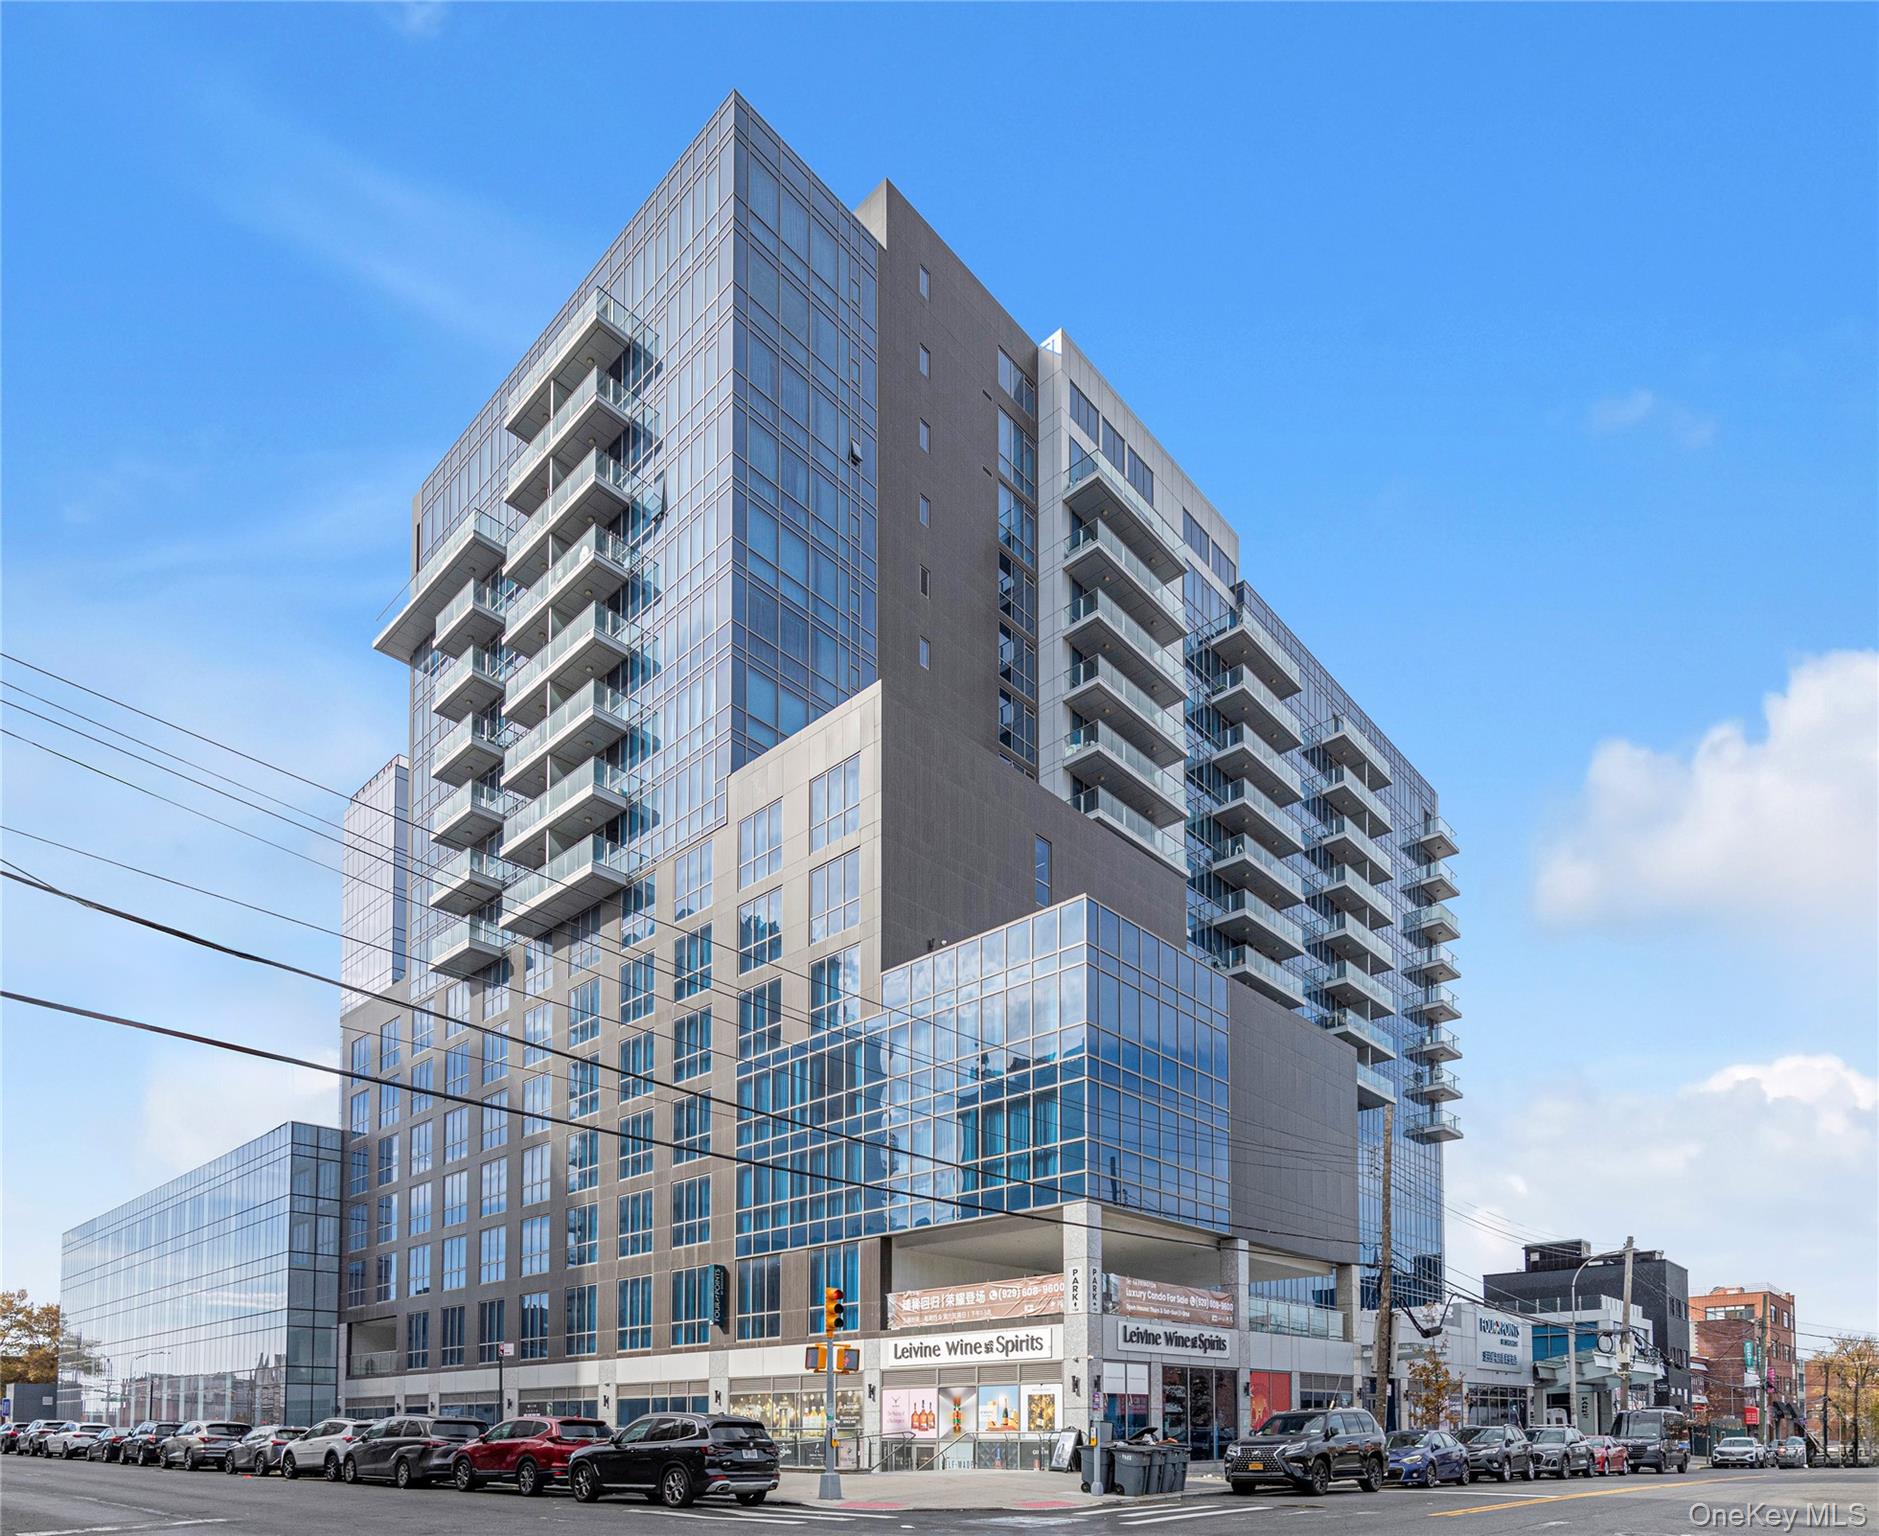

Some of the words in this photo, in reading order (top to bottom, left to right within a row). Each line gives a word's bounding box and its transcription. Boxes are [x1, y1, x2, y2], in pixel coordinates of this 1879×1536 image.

[1071, 1268, 1079, 1301] PARK
[1125, 1288, 1147, 1302] Luxury
[1147, 1291, 1167, 1302] Condo
[1167, 1293, 1176, 1303] For
[1177, 1295, 1189, 1305] Sale
[893, 1342, 941, 1360] Leivine
[945, 1339, 983, 1356] Wine
[995, 1334, 1044, 1358] Spirits
[1123, 1325, 1162, 1346] Leivine
[1164, 1330, 1191, 1348] Wine
[1197, 1333, 1228, 1354] Spirits
